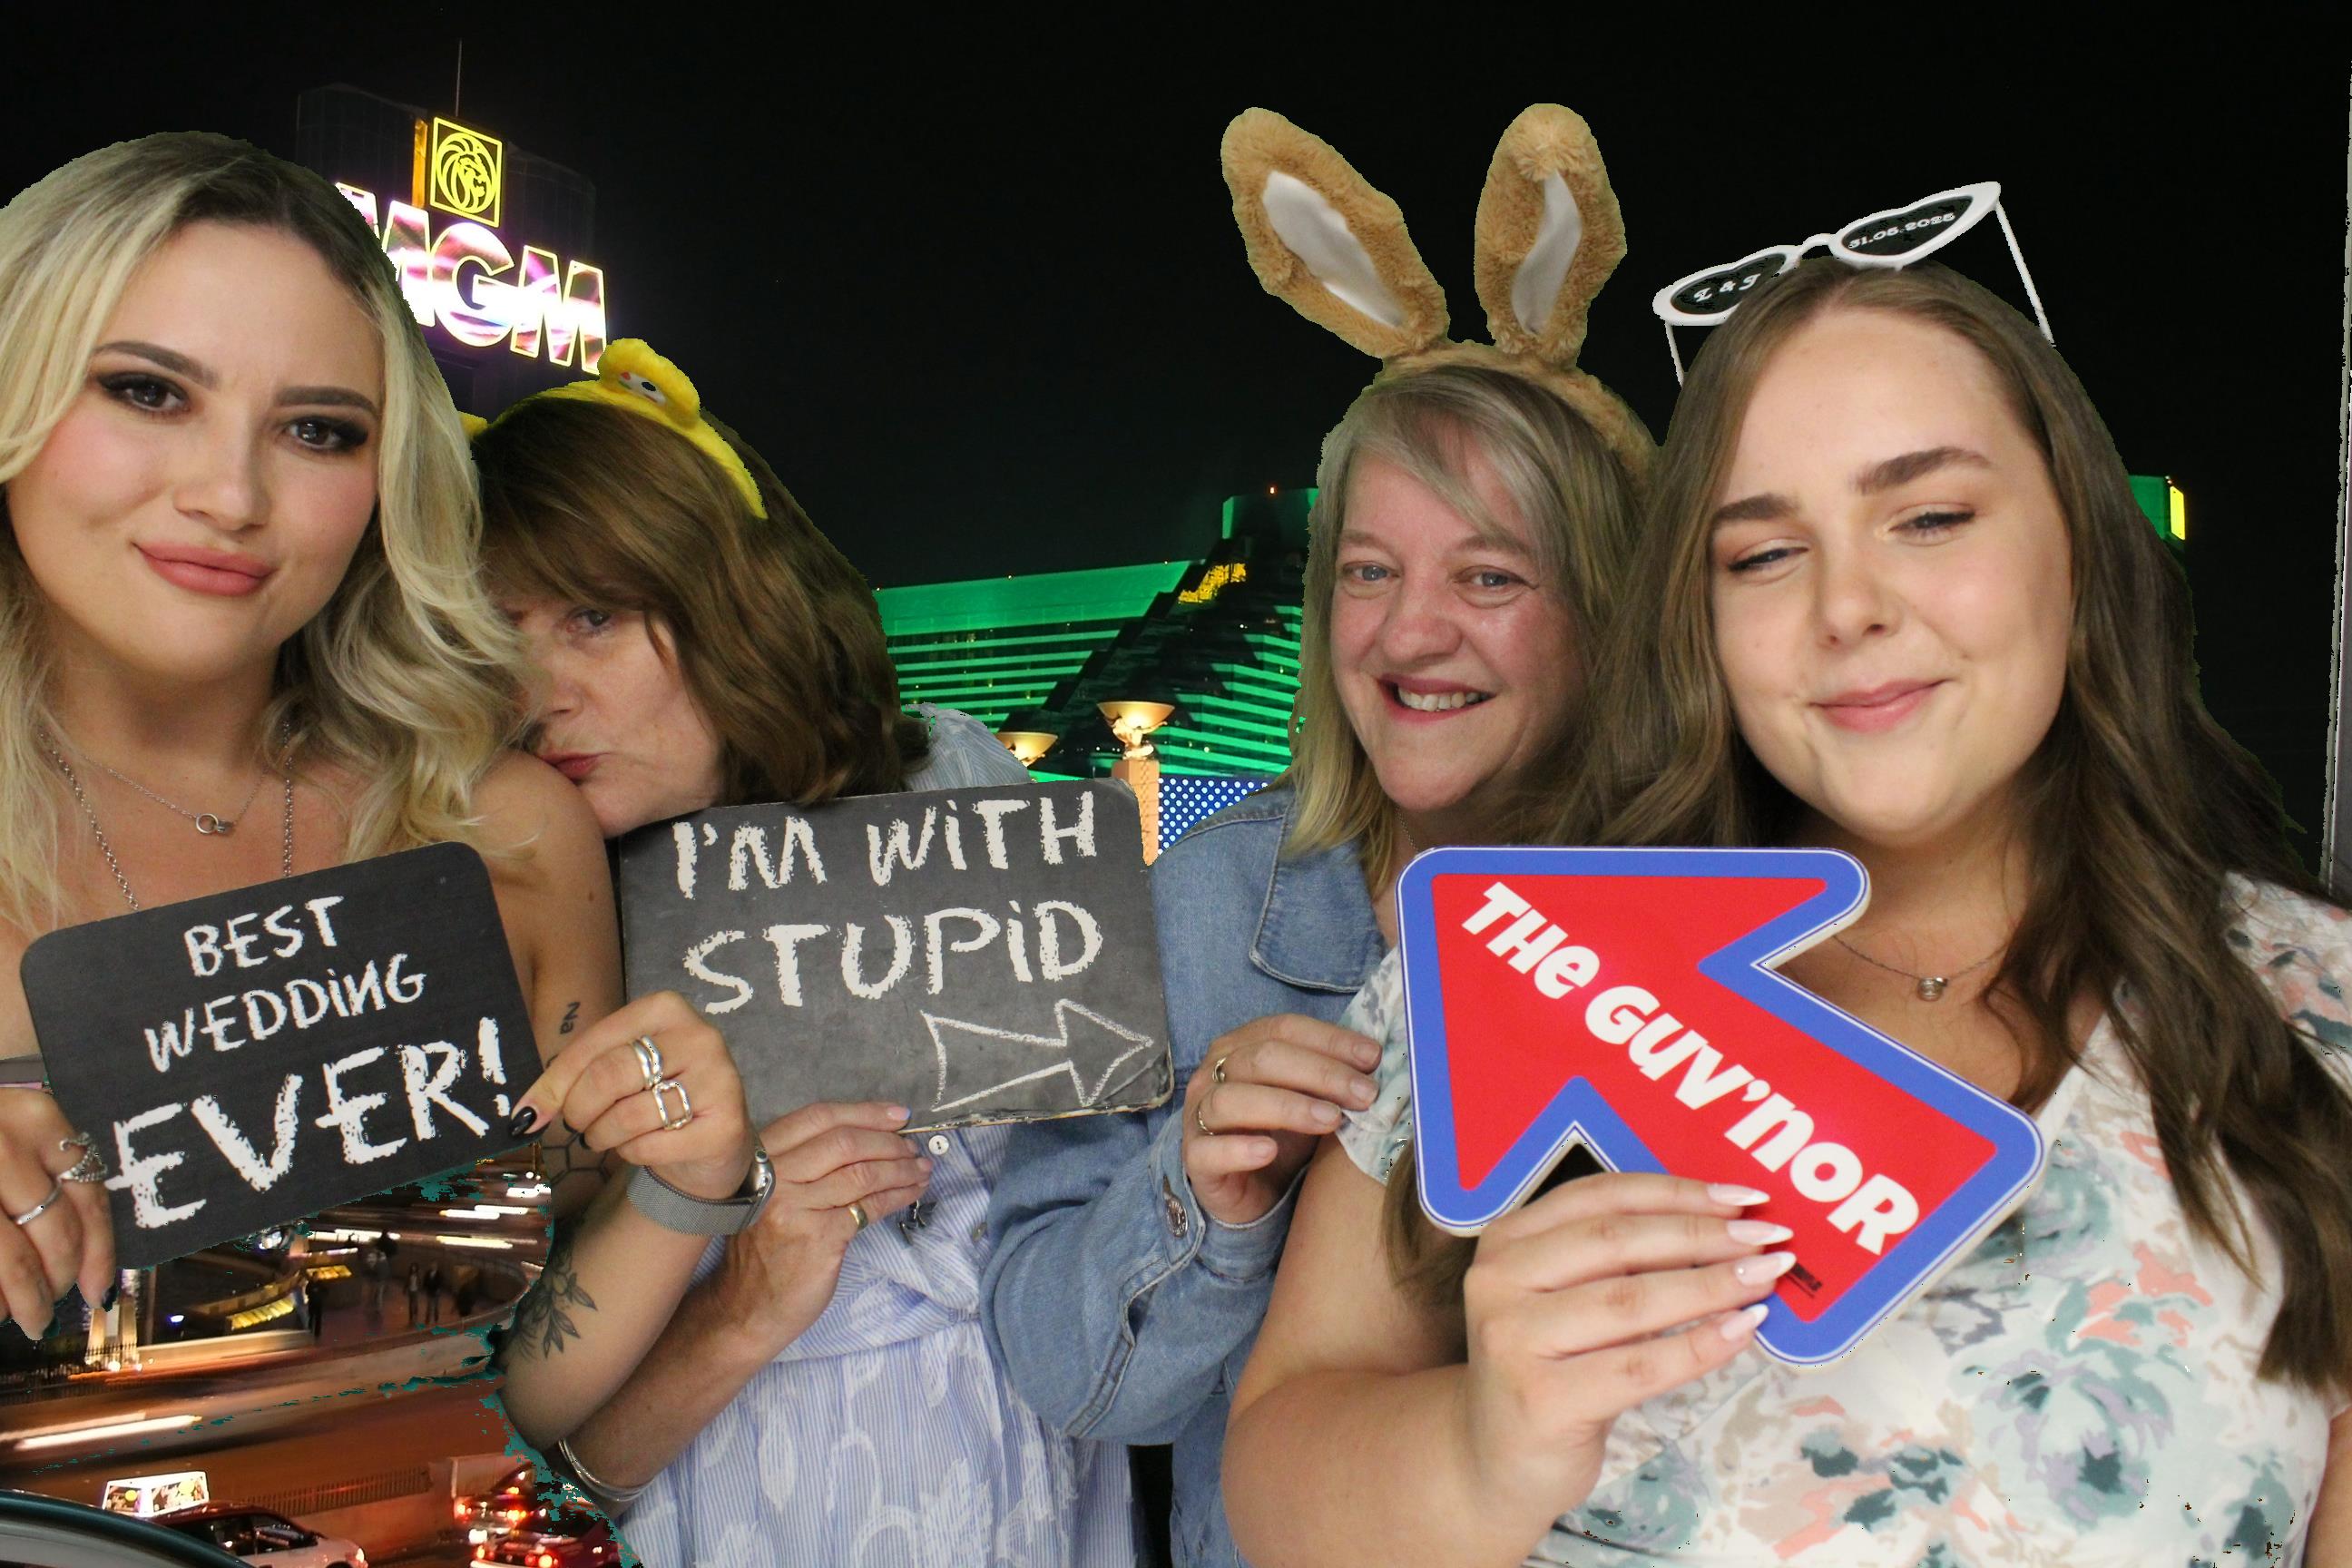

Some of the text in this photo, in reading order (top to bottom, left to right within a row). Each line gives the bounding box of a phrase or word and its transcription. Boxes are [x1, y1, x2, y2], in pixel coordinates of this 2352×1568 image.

[336, 182, 606, 376] MGM
[673, 815, 828, 899] I'M
[184, 896, 344, 977] BEST
[104, 1016, 511, 1229] EVER!
